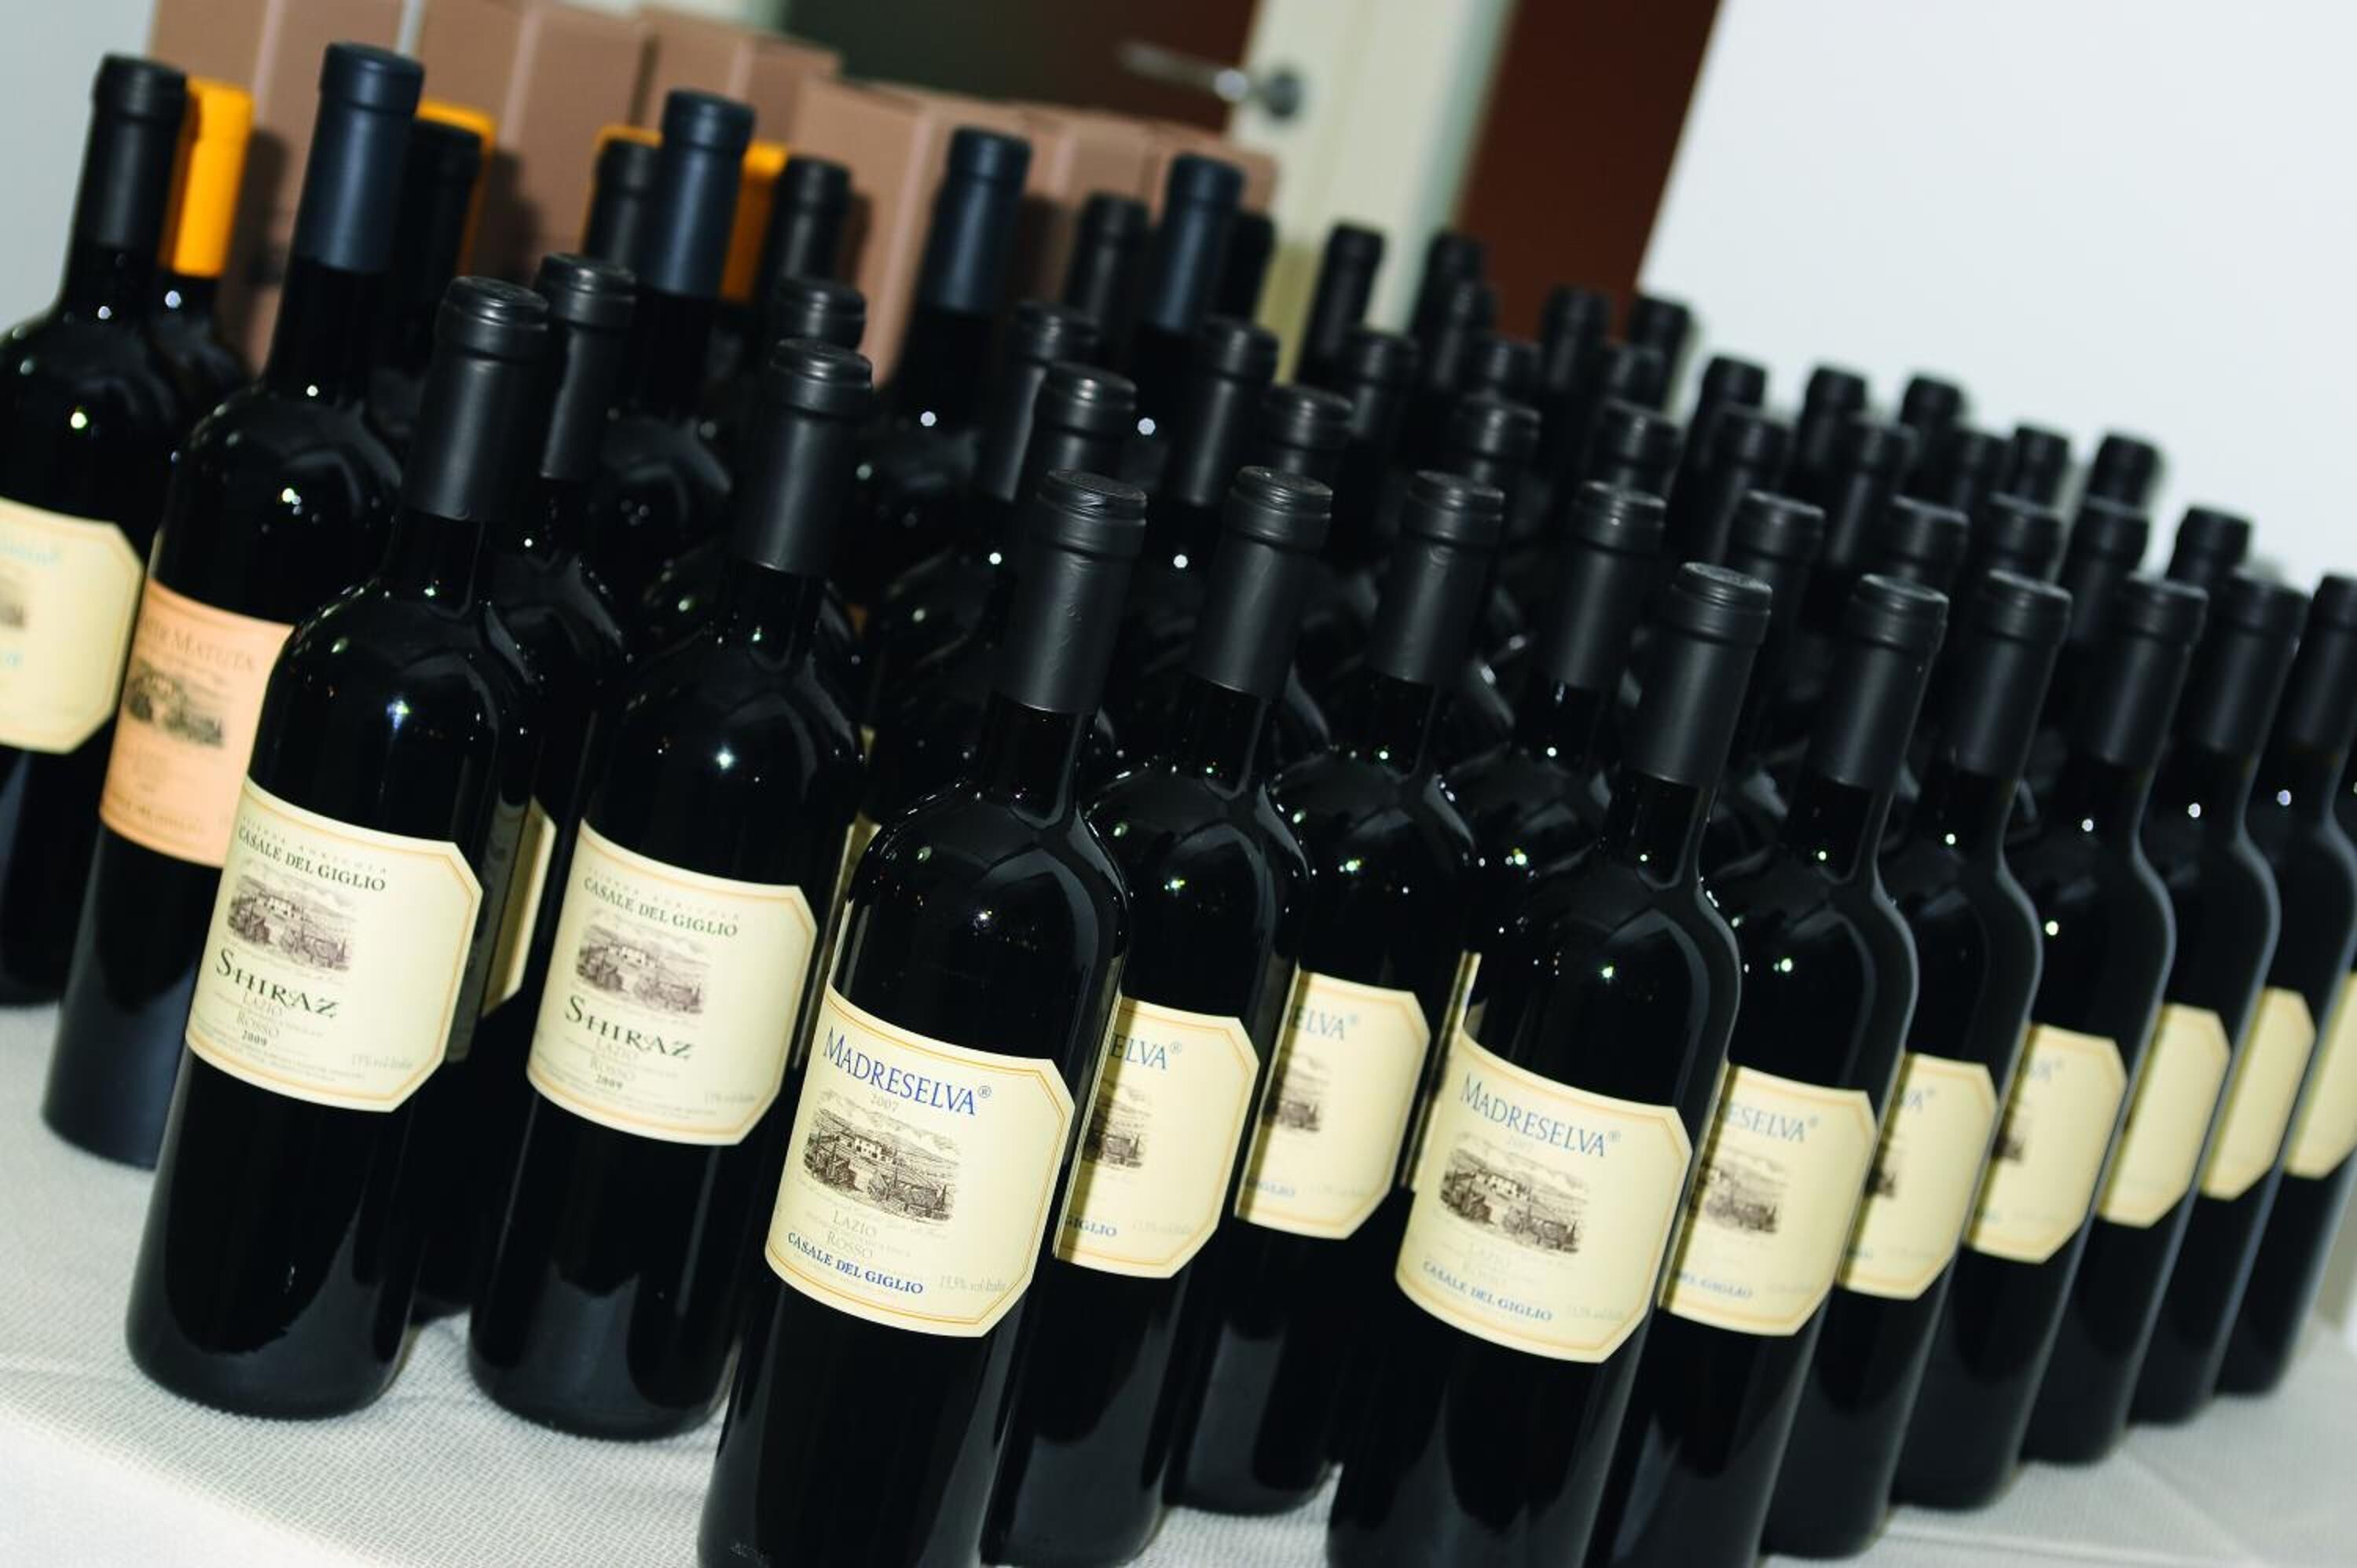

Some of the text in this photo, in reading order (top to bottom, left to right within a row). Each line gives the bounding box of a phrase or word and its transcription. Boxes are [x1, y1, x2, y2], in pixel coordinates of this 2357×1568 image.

[238, 826, 282, 862] CASALE
[285, 852, 314, 874] DEL
[317, 864, 386, 892] GIGLIO
[584, 877, 635, 912] CASALE
[639, 903, 669, 923] DEL
[672, 914, 739, 938] GIGLIO
[216, 947, 340, 1018] SHIRAZ
[241, 1030, 268, 1047] 2009
[565, 995, 694, 1061] SHIRAZ
[788, 1233, 923, 1295] CASALE DEL GIGLIO
[1423, 1260, 1468, 1292] CASALE
[1471, 1286, 1494, 1305] DEL
[1497, 1298, 1552, 1321] GIGLIO
